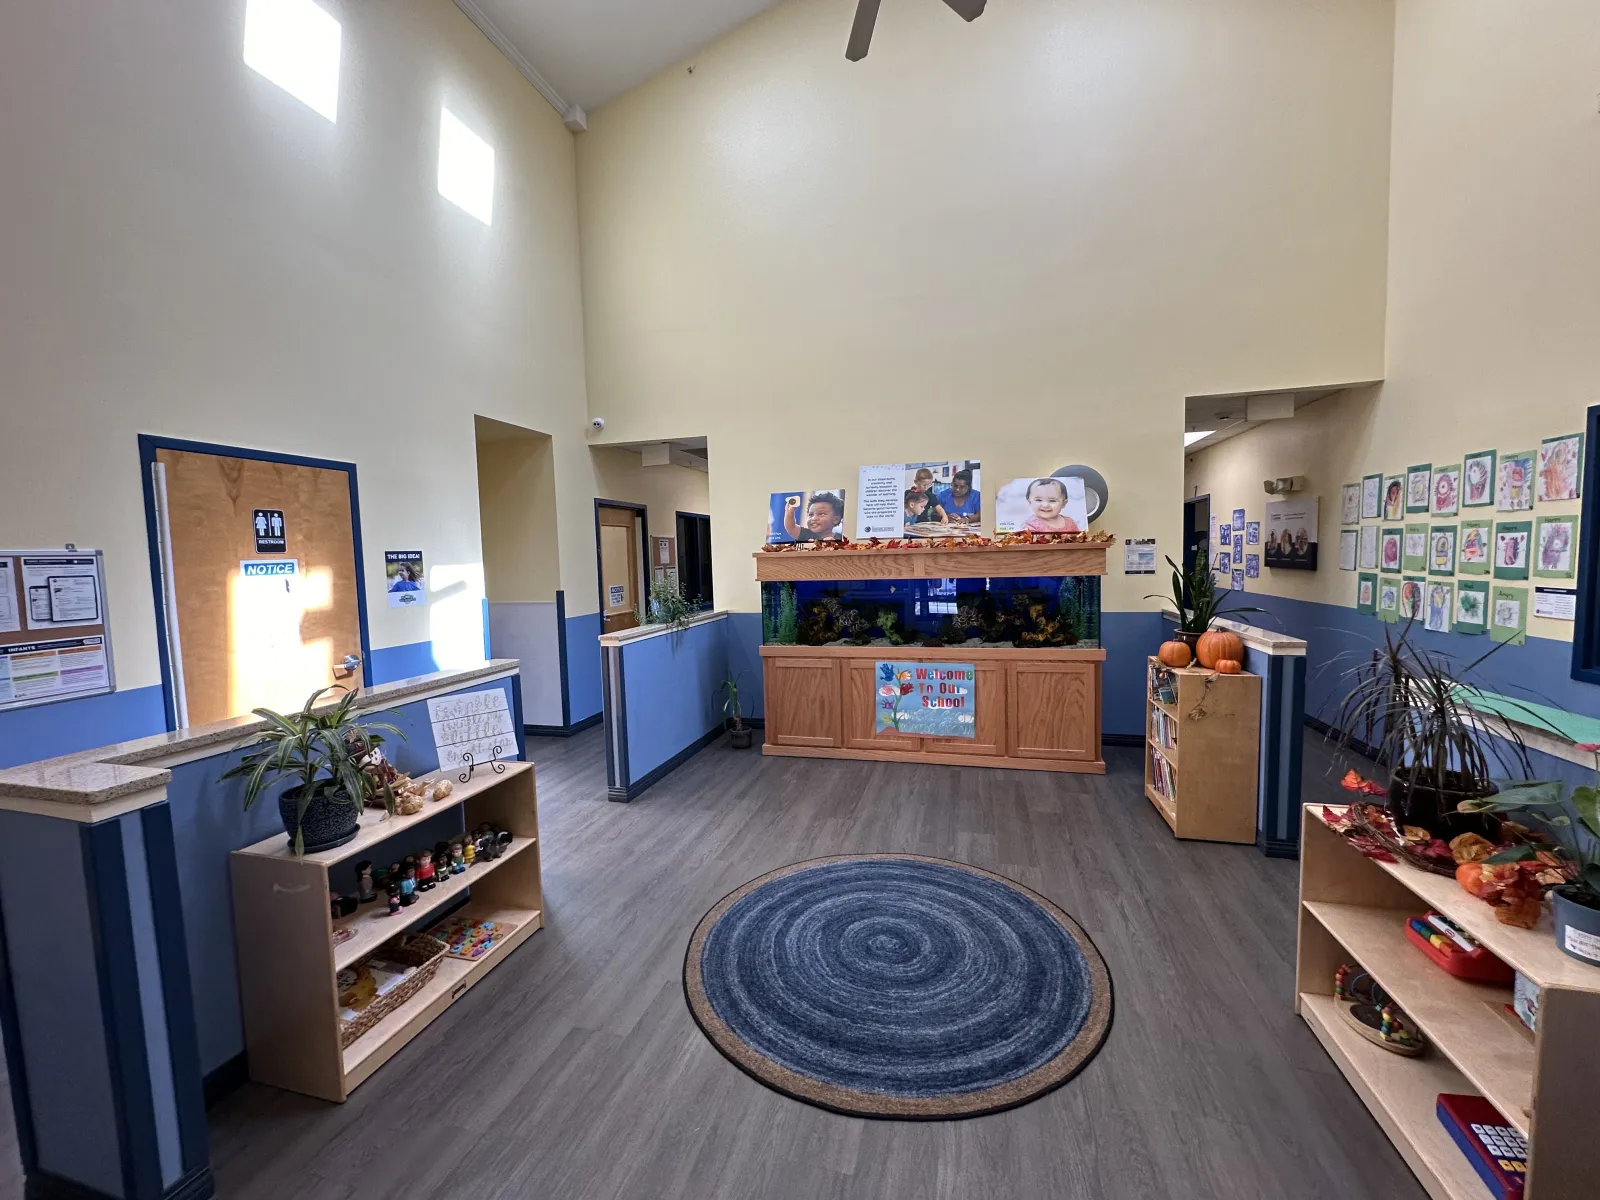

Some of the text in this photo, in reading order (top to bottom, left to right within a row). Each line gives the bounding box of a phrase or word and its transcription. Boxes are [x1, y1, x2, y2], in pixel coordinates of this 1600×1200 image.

[247, 564, 293, 575] NOTICE
[8, 645, 36, 653] INFANTS
[915, 668, 974, 680] Welcome
[918, 682, 961, 694] To Our
[922, 695, 965, 708] School
